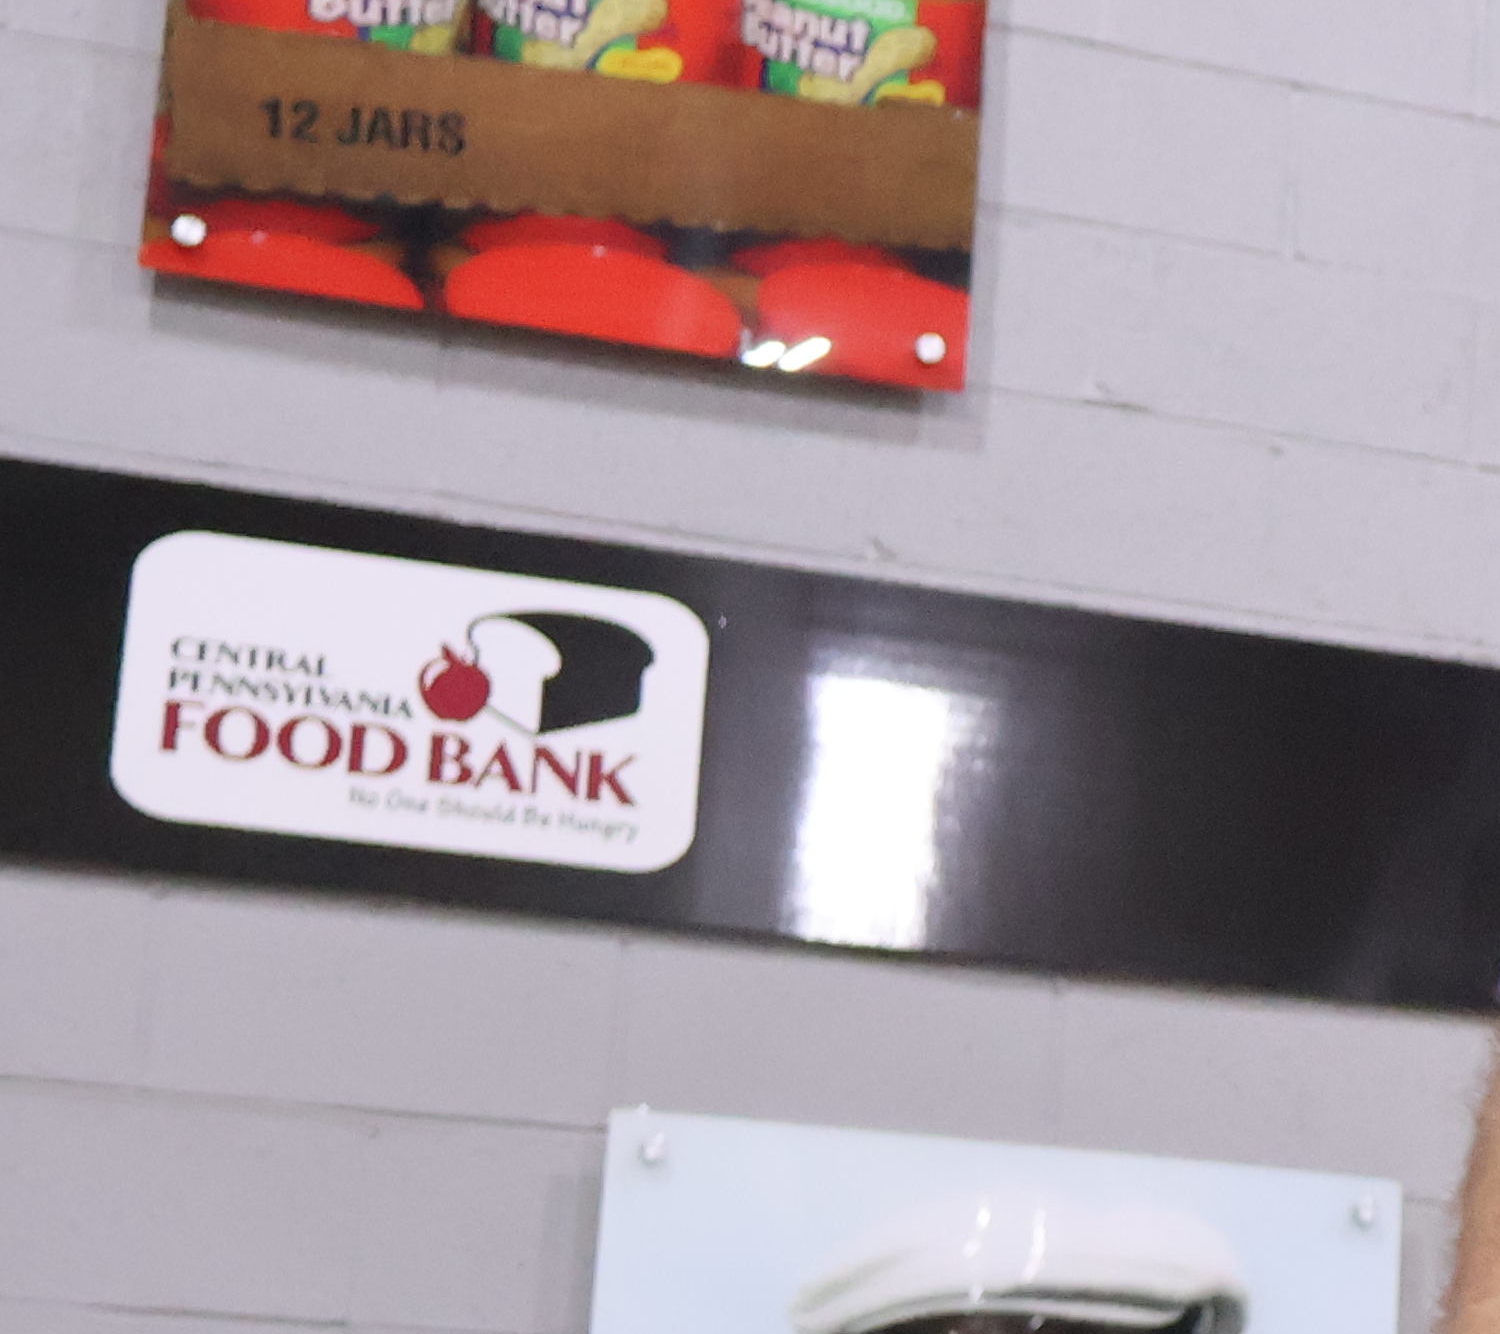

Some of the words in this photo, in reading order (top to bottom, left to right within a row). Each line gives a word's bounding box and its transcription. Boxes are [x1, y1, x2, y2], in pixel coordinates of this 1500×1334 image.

[258, 97, 320, 145] 12
[336, 103, 468, 158] JARS
[169, 634, 330, 678] CENTRAL
[166, 666, 415, 720] PENNSYLVANIA
[158, 698, 409, 777] FOOD
[426, 731, 636, 807] BANK
